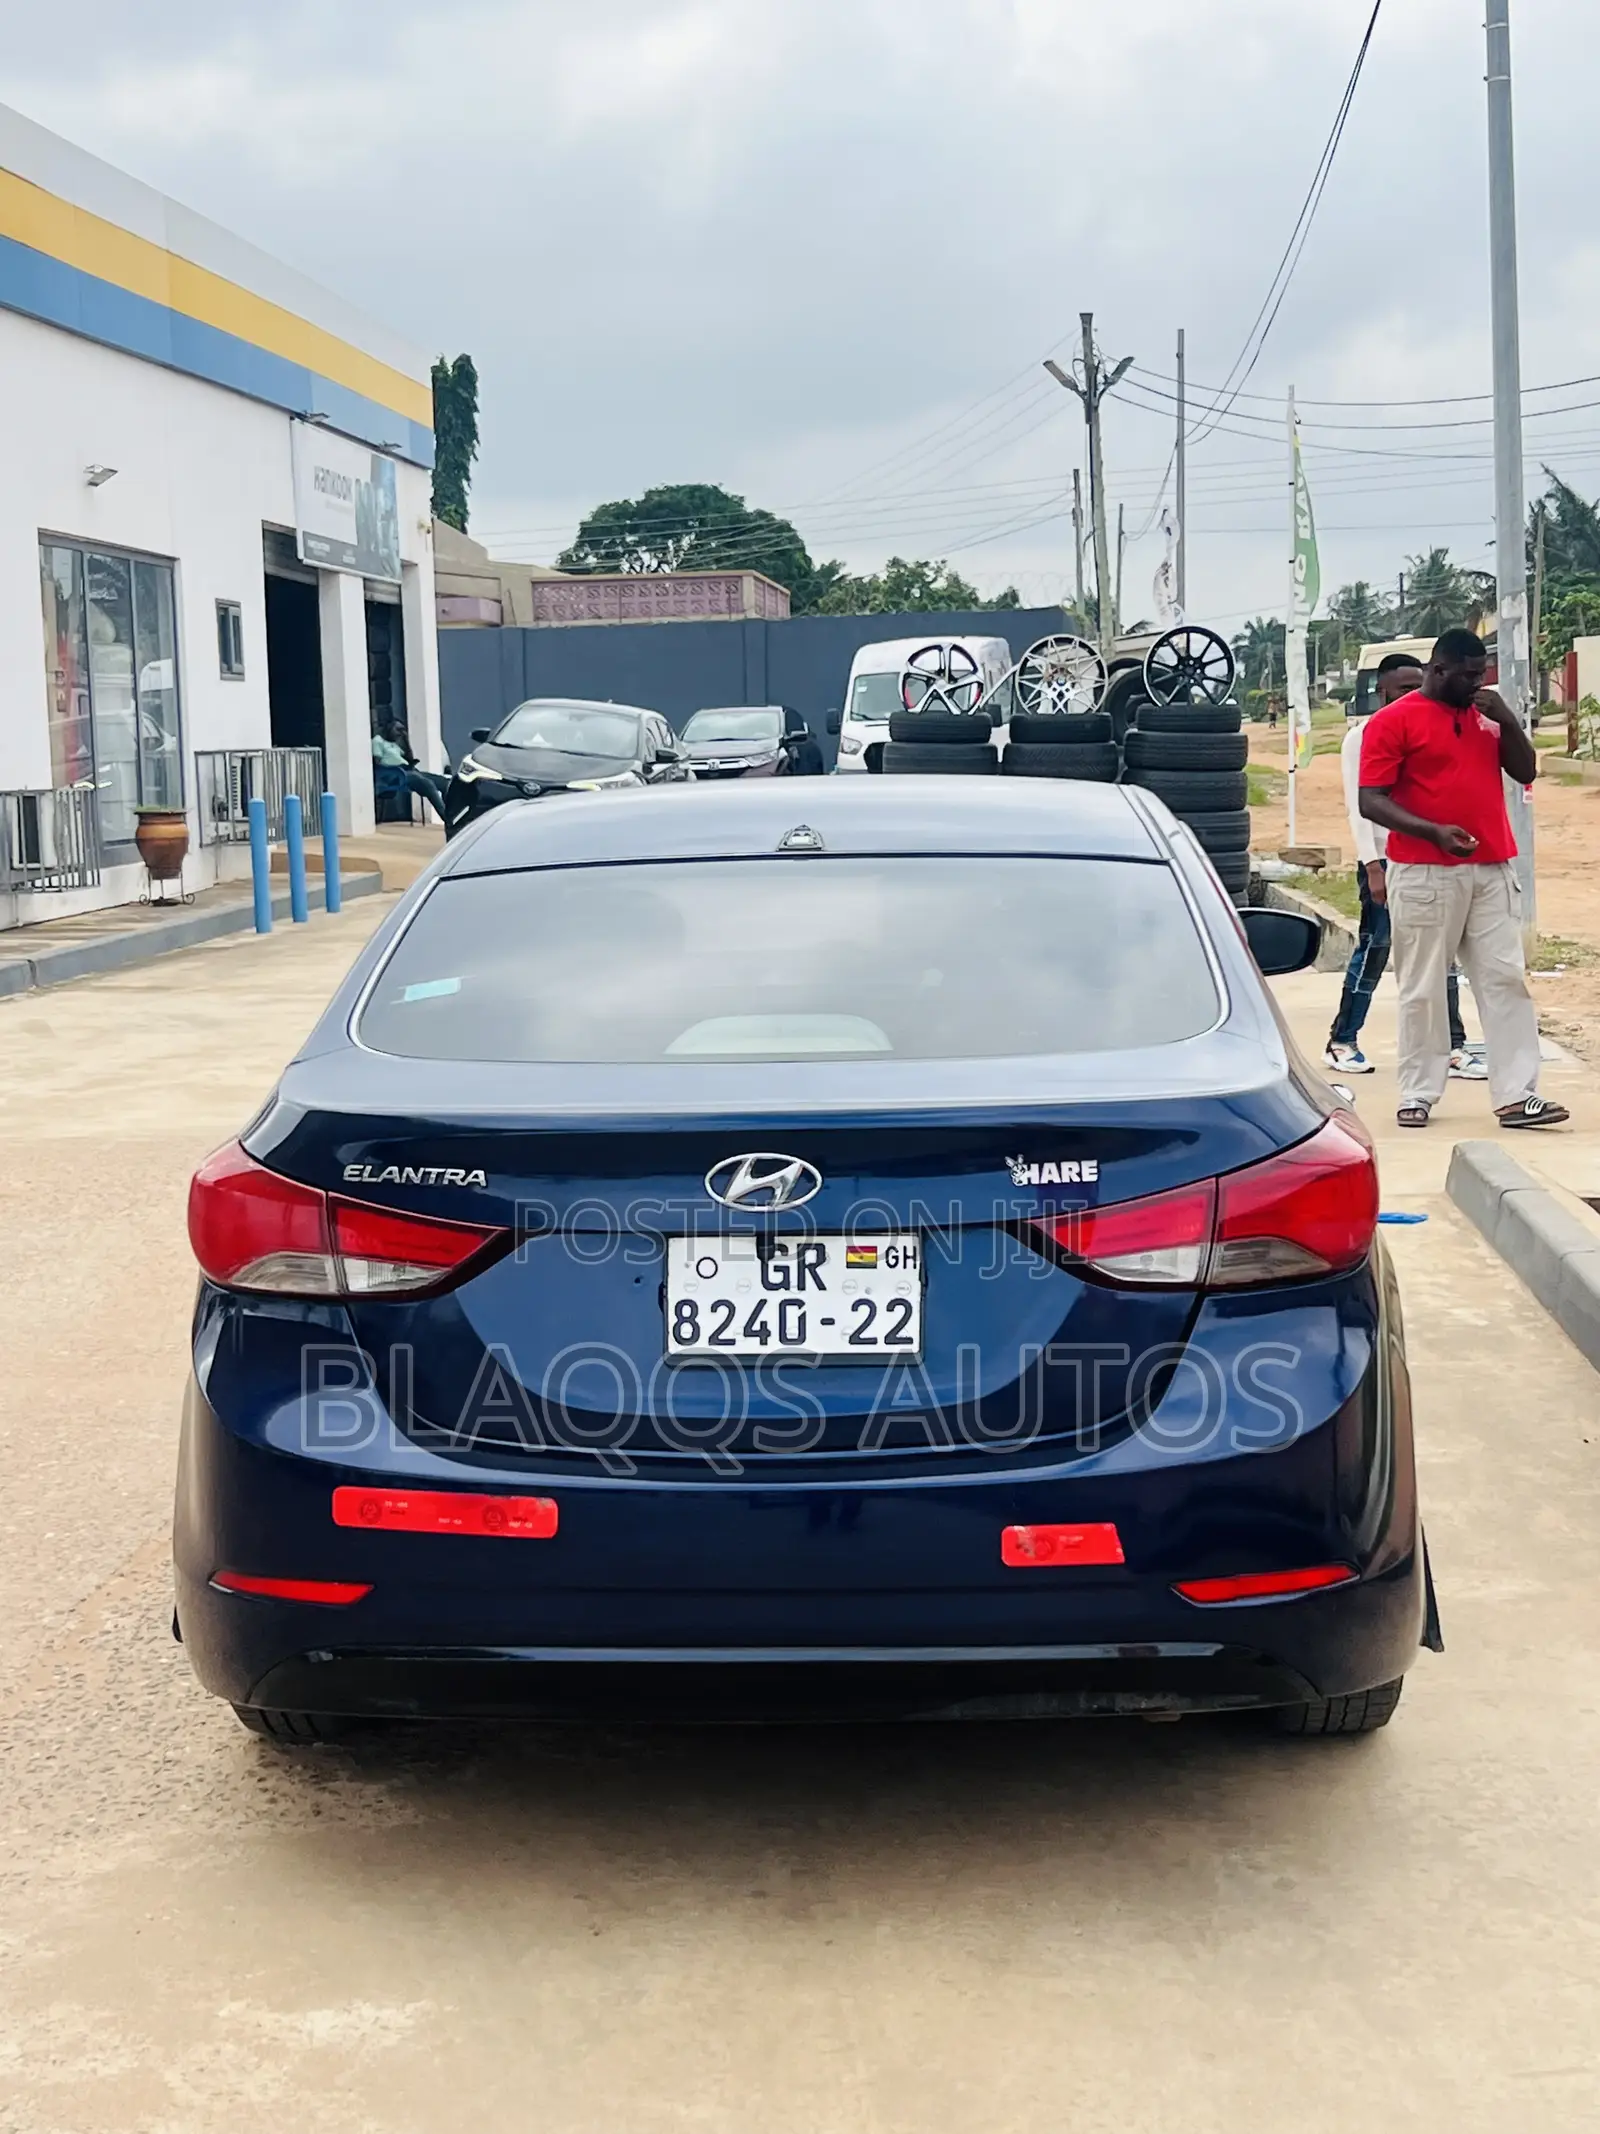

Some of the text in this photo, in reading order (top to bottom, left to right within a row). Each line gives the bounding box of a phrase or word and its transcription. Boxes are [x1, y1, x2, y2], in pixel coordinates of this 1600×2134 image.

[343, 1164, 488, 1187] ELANTRA
[760, 1243, 827, 1291] GR
[885, 1246, 917, 1269] GH
